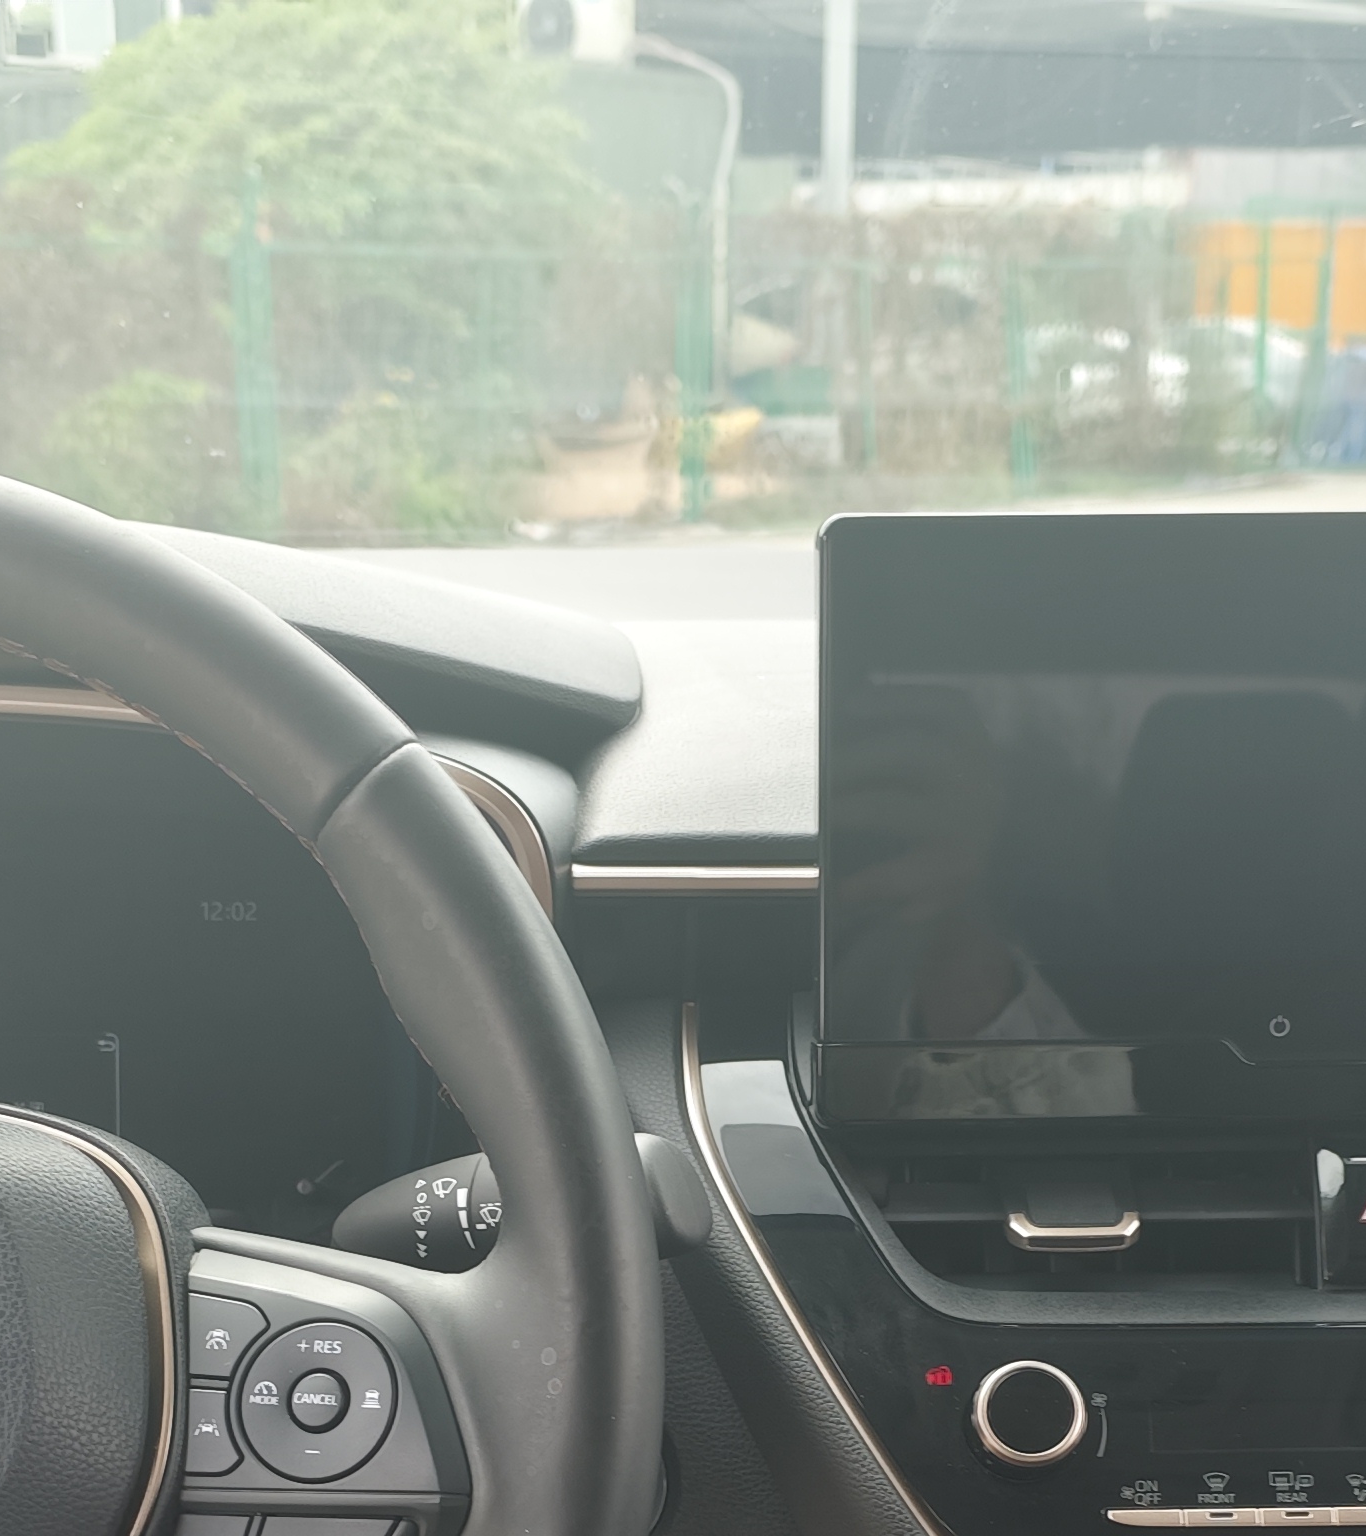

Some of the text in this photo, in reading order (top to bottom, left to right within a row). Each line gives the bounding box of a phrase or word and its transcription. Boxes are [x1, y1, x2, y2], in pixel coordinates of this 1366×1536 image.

[200, 901, 257, 921] 12:02
[248, 1395, 280, 1405] MODE
[293, 1392, 338, 1406] CANCEL
[1134, 1480, 1158, 1492] ON
[1134, 1493, 1162, 1506] OFF
[1197, 1493, 1236, 1504] FRONT
[1276, 1492, 1309, 1503] REAR
